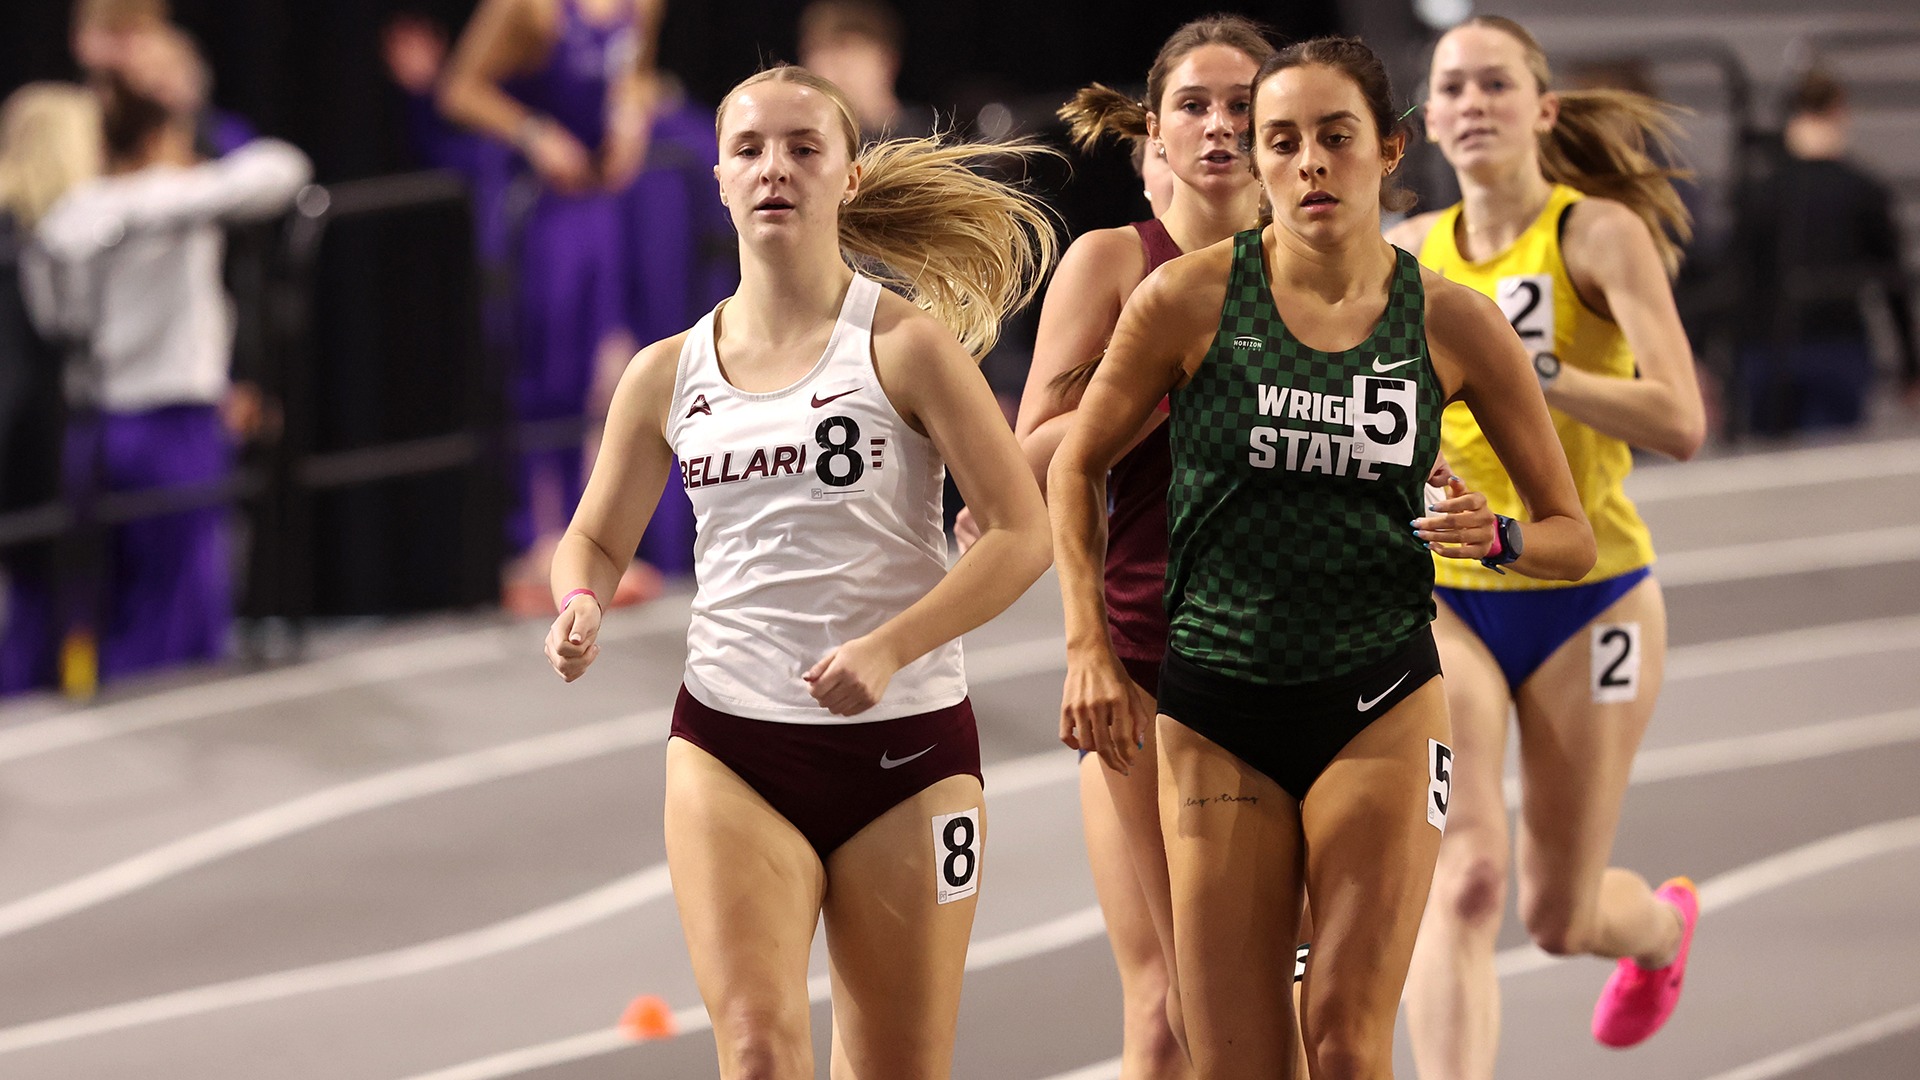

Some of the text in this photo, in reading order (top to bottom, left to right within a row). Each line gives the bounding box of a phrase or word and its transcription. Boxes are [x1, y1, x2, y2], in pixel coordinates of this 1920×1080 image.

[1507, 281, 1544, 339] 2
[1362, 377, 1409, 446] 5
[815, 415, 865, 487] 8
[1600, 629, 1630, 687] 2
[1433, 743, 1451, 816] 5
[943, 816, 975, 887] 8
